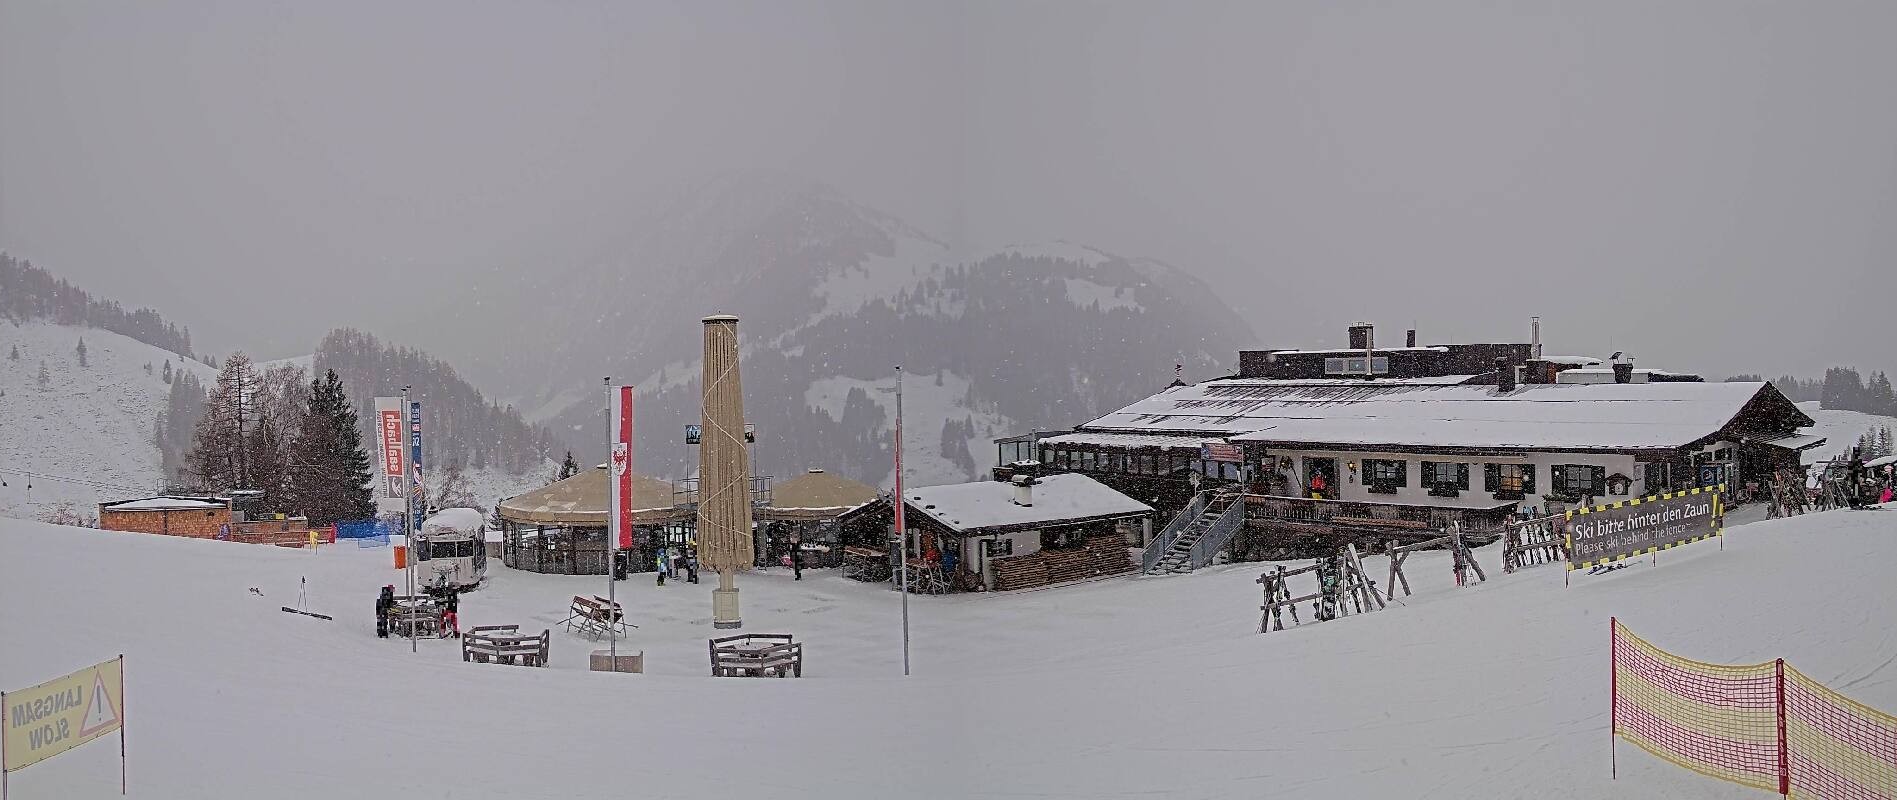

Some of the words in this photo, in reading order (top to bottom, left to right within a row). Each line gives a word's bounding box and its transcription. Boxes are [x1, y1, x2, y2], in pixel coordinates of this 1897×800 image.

[1575, 521, 1593, 540] Ski
[1597, 519, 1624, 536] bitte
[1627, 512, 1661, 530] hinter
[1662, 505, 1681, 522] den
[1684, 503, 1710, 518] Zaun
[1575, 541, 1604, 556] Please
[1606, 535, 1618, 549] ski
[1620, 528, 1649, 546] behind
